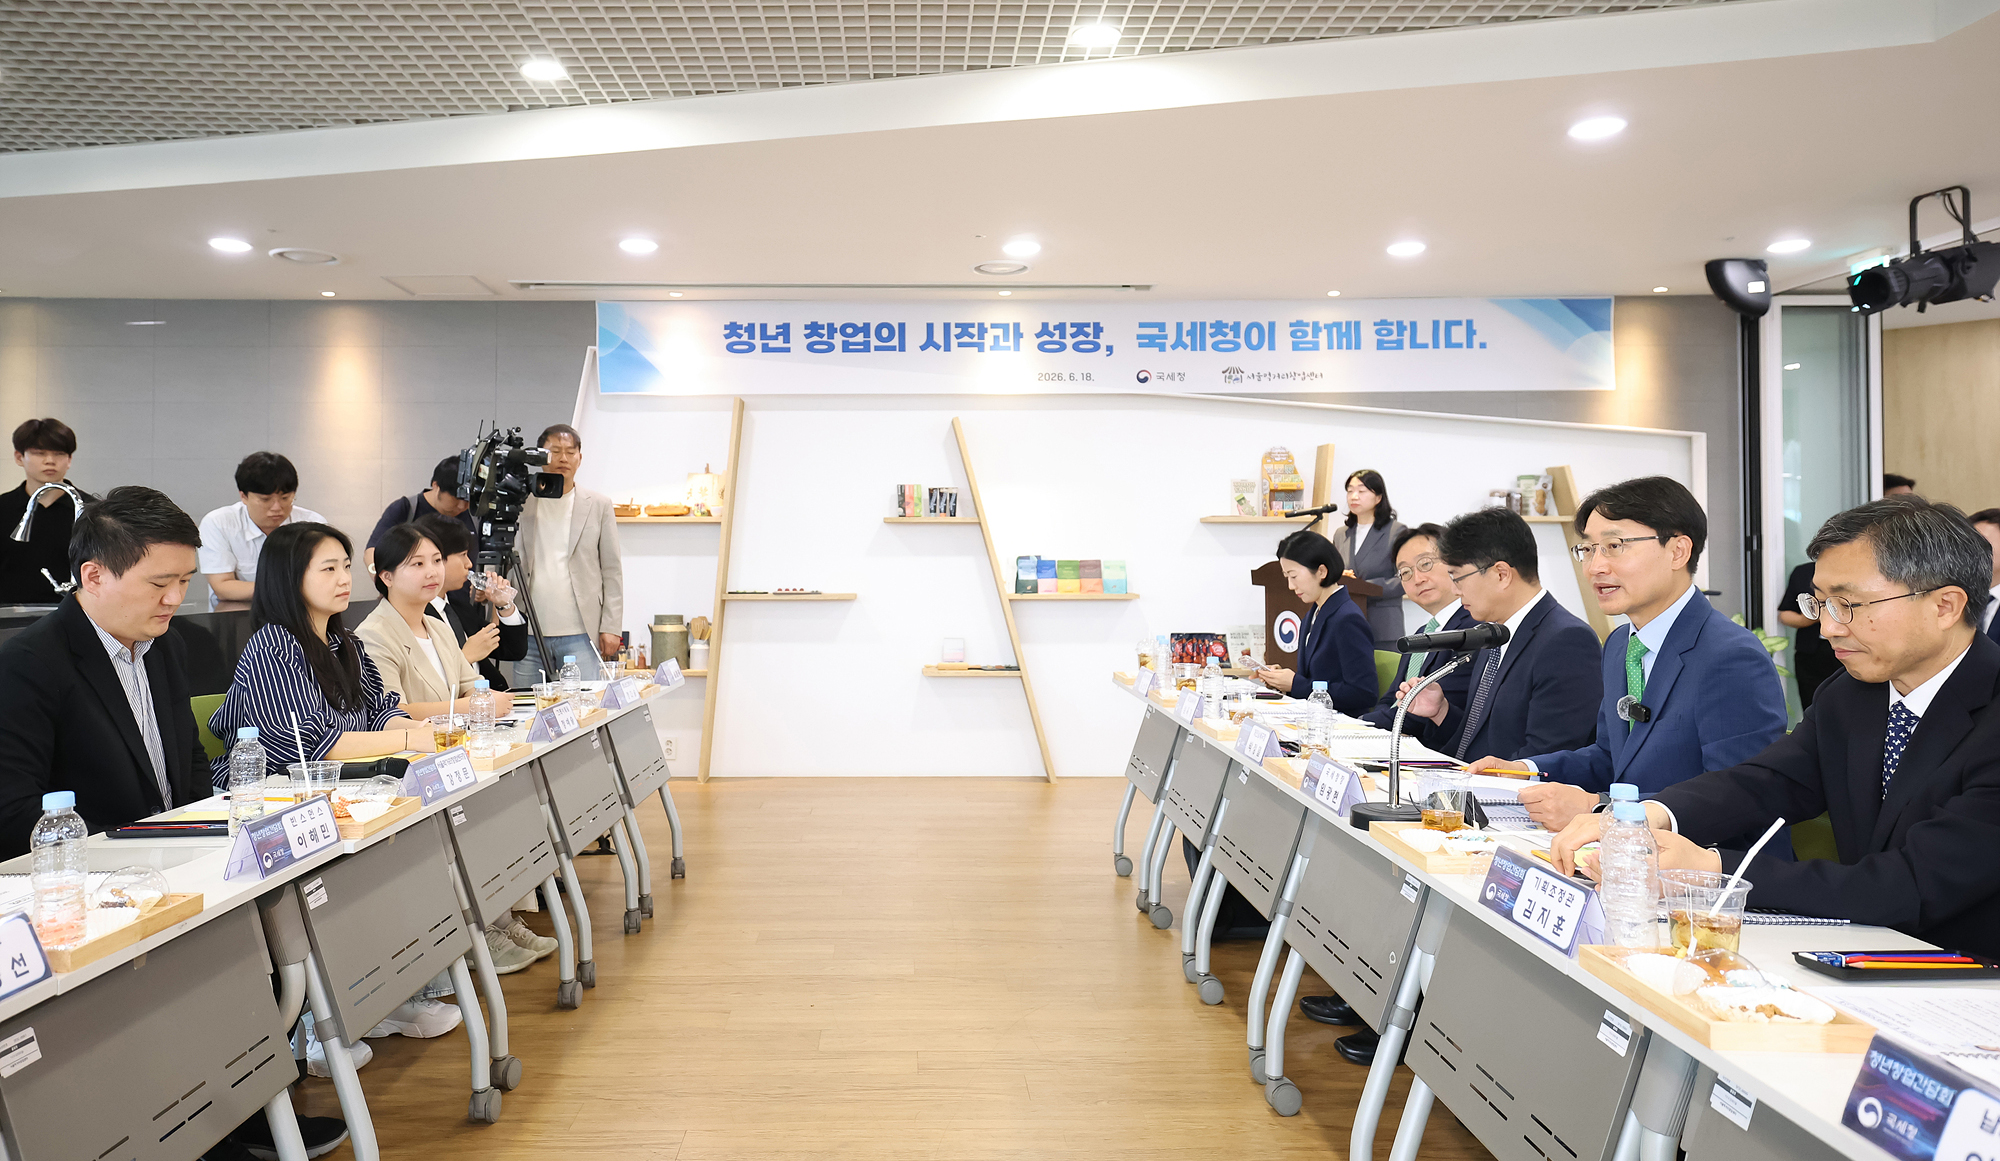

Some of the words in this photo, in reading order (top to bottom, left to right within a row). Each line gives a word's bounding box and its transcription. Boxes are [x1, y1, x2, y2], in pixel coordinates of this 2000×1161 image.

[723, 321, 792, 354] 청년
[803, 321, 907, 354] 창업의
[918, 321, 1024, 353] 시작과
[1034, 321, 1115, 357] 성장,
[1136, 319, 1277, 353] 국세청이
[1289, 319, 1362, 352] 함께
[1373, 318, 1488, 351] 합니다.
[1037, 372, 1067, 382] 2026.
[1155, 371, 1186, 382] 국세청
[297, 822, 331, 849] 이해민
[1535, 876, 1576, 908] 기획조정관
[1522, 898, 1567, 937] 김지훈
[1869, 1050, 1958, 1109] 청년창업간담회
[1886, 1112, 1919, 1140] 국세청
